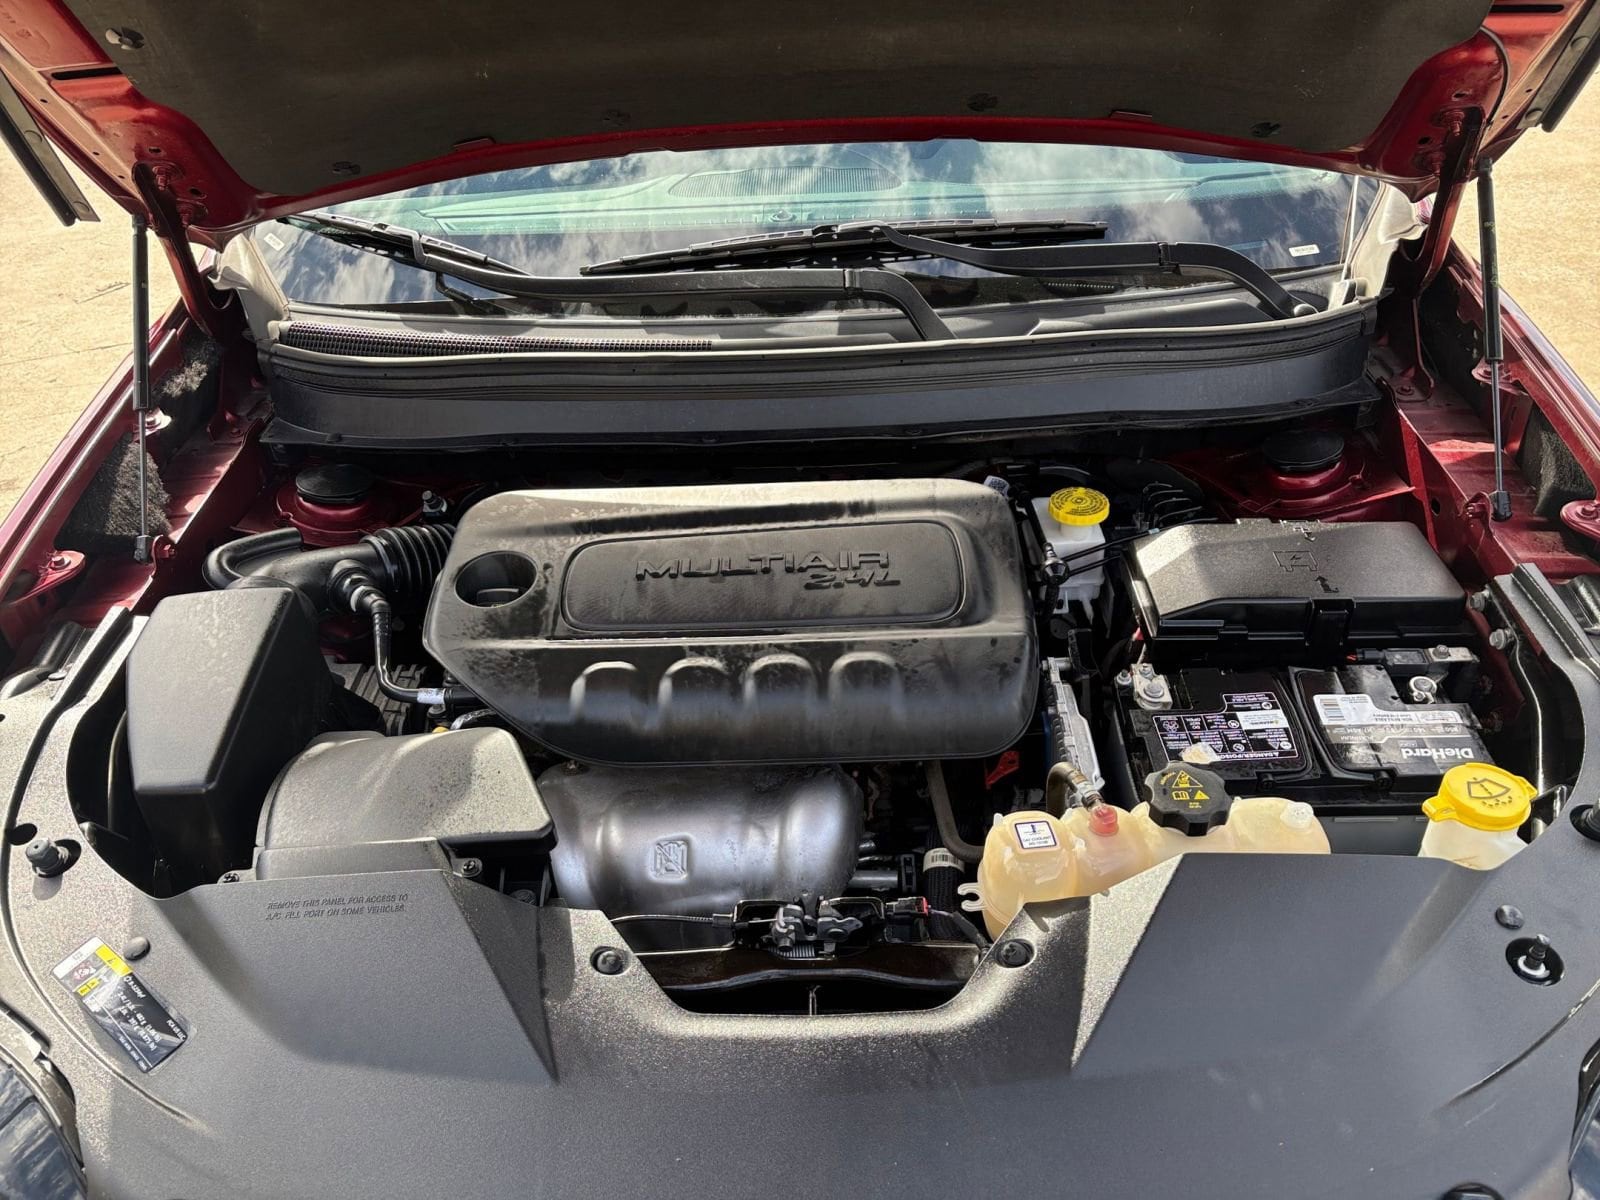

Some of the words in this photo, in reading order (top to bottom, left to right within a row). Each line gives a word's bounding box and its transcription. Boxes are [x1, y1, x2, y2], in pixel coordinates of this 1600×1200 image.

[635, 551, 890, 581] MULTIAIR
[803, 569, 900, 590] 2.4L
[1402, 746, 1475, 760] DieHard
[267, 900, 300, 910] REMOVE
[302, 899, 320, 908] THIS
[321, 898, 347, 906] PANEL
[348, 896, 364, 905] FOR
[365, 894, 396, 904] ACCESS
[398, 893, 409, 902] TO
[265, 912, 281, 921] A/C
[284, 910, 301, 919] FILL
[303, 909, 325, 918] PORT
[327, 907, 340, 916] ON
[341, 906, 364, 916] SOME
